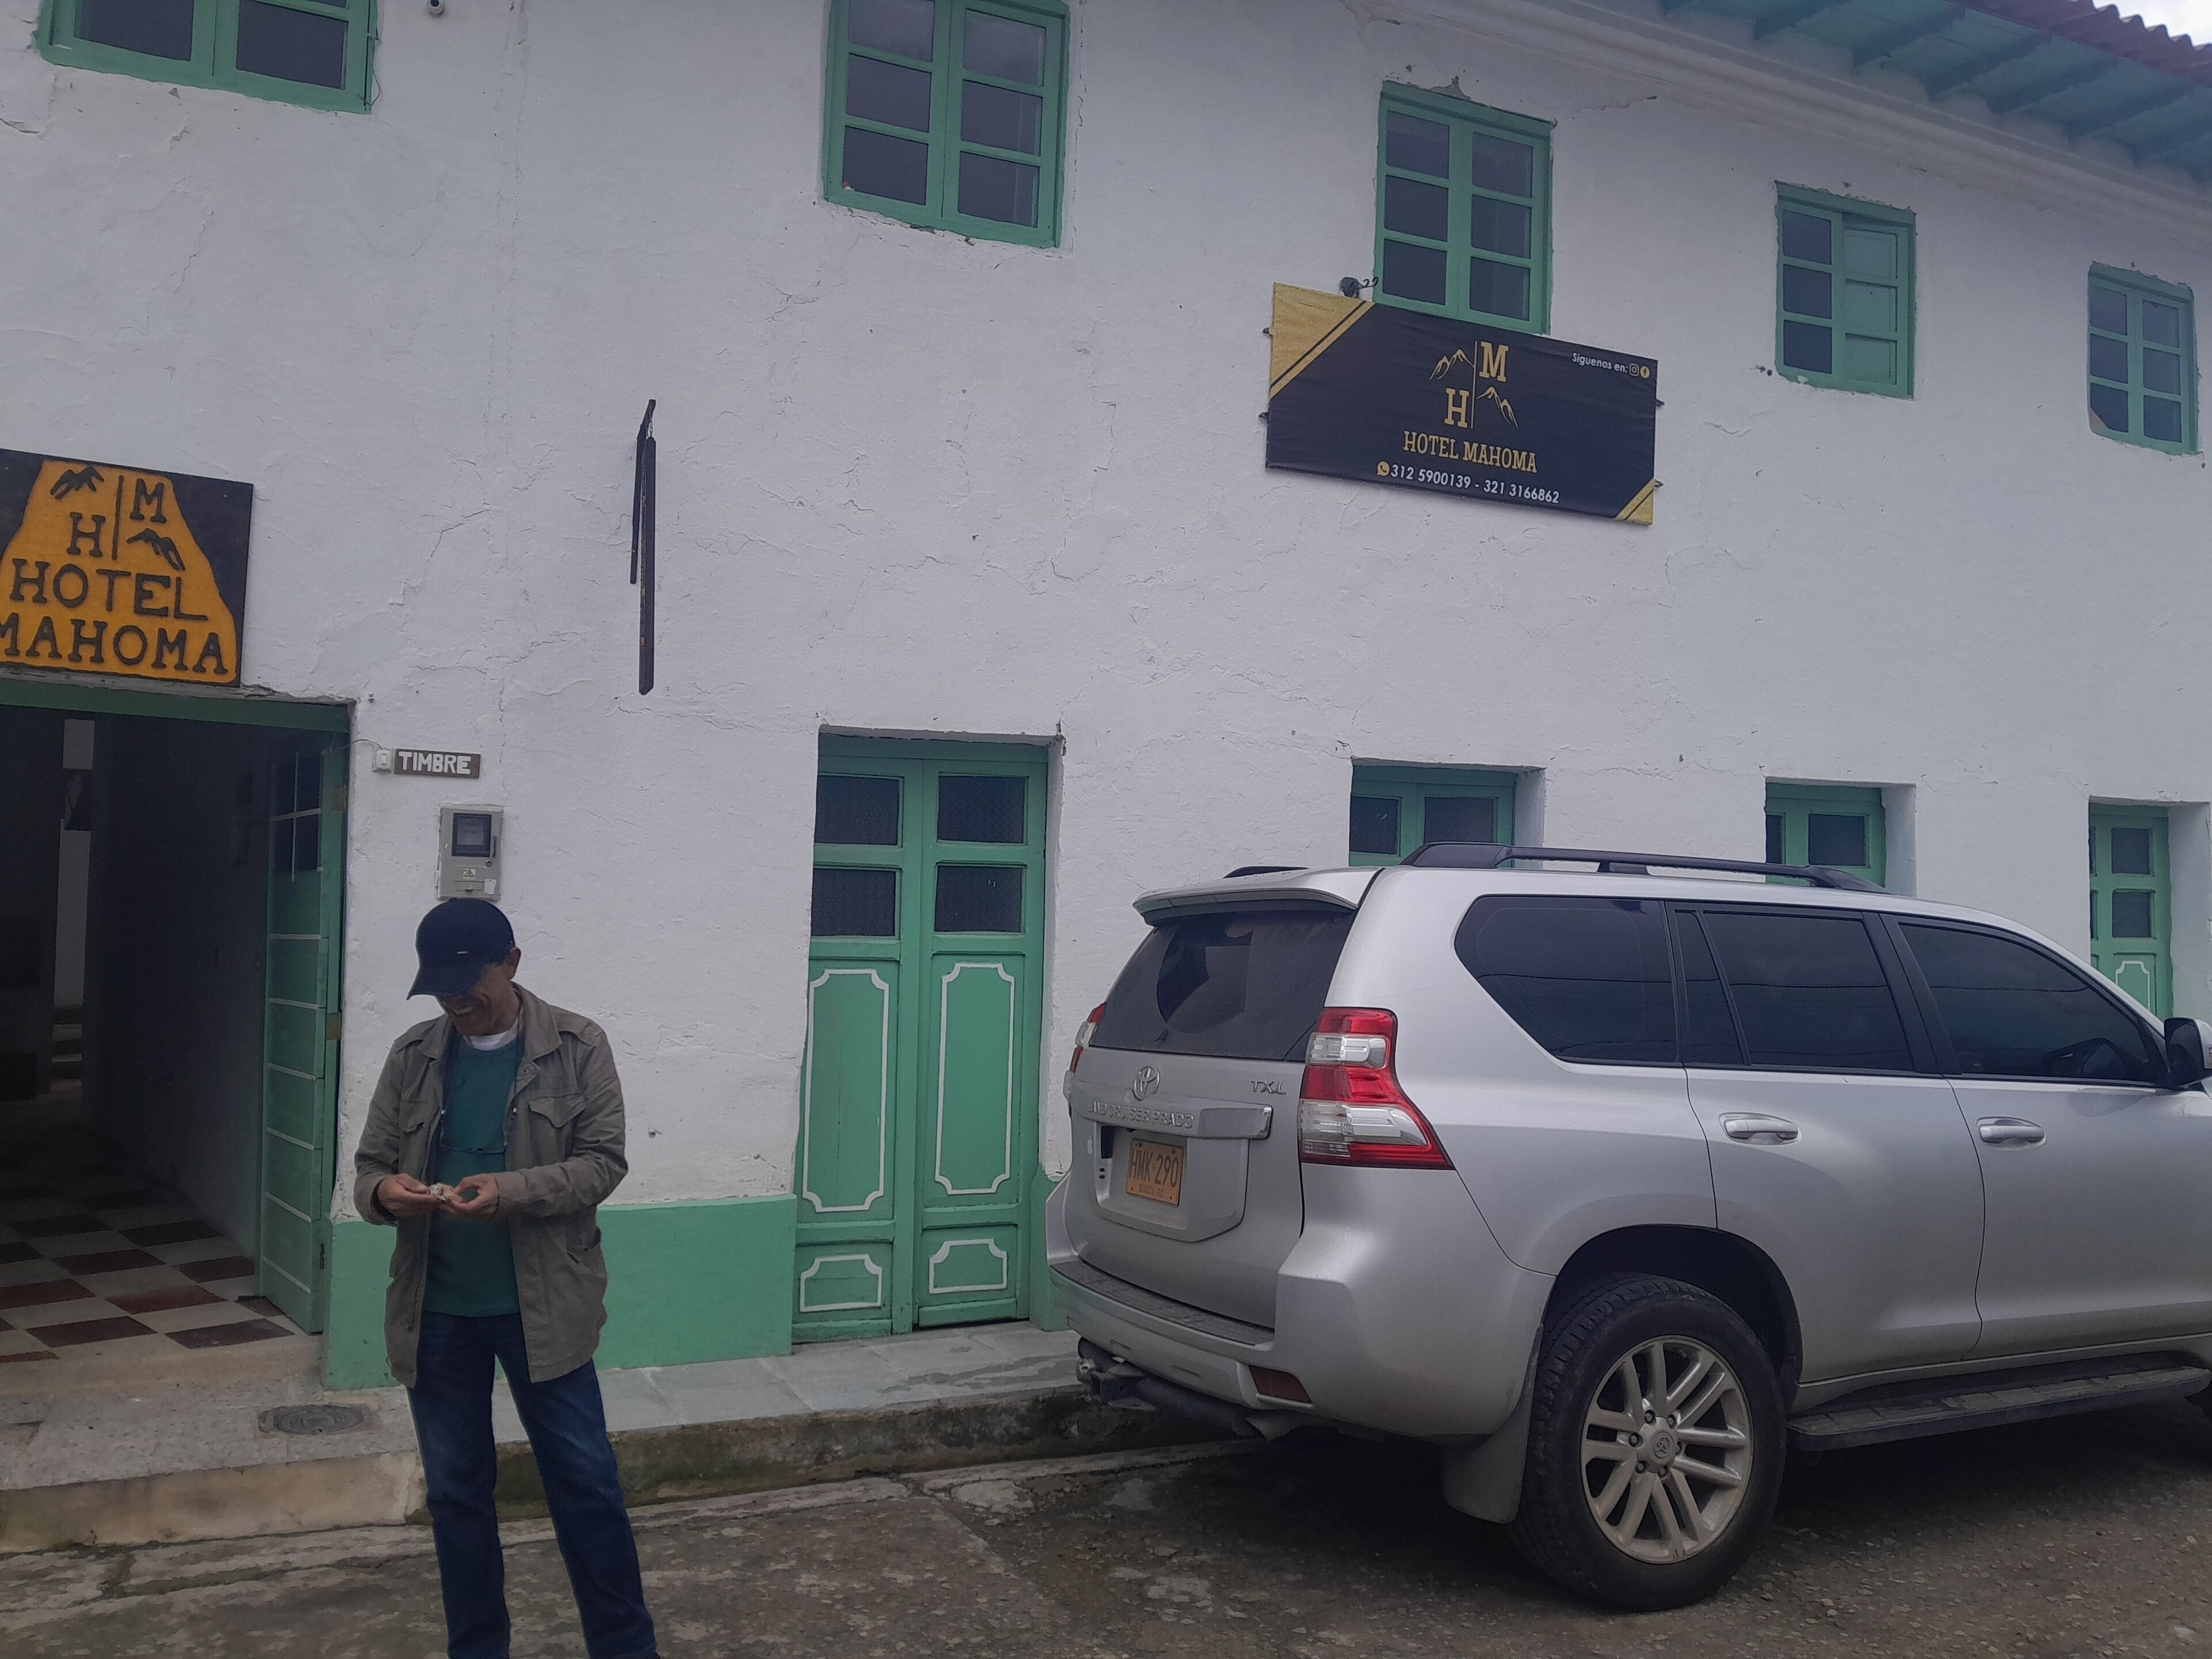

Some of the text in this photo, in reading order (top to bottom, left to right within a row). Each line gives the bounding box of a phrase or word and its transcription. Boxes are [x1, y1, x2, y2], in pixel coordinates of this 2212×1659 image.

[1479, 341, 1509, 382] M
[1614, 363, 1628, 373] en:
[1444, 388, 1469, 429] H
[1403, 430, 1537, 474] HOTEL MAHOMA
[130, 478, 166, 523] M
[1391, 464, 1414, 480] 312
[1418, 468, 1471, 489] 5900139
[1483, 479, 1505, 495] 321
[1508, 483, 1560, 504] 3166862
[67, 512, 105, 557] H
[10, 558, 209, 621] HOTEL
[398, 751, 471, 775] TIMBRE
[1250, 1080, 1287, 1096] TXL
[1152, 1109, 1195, 1129] PRADO
